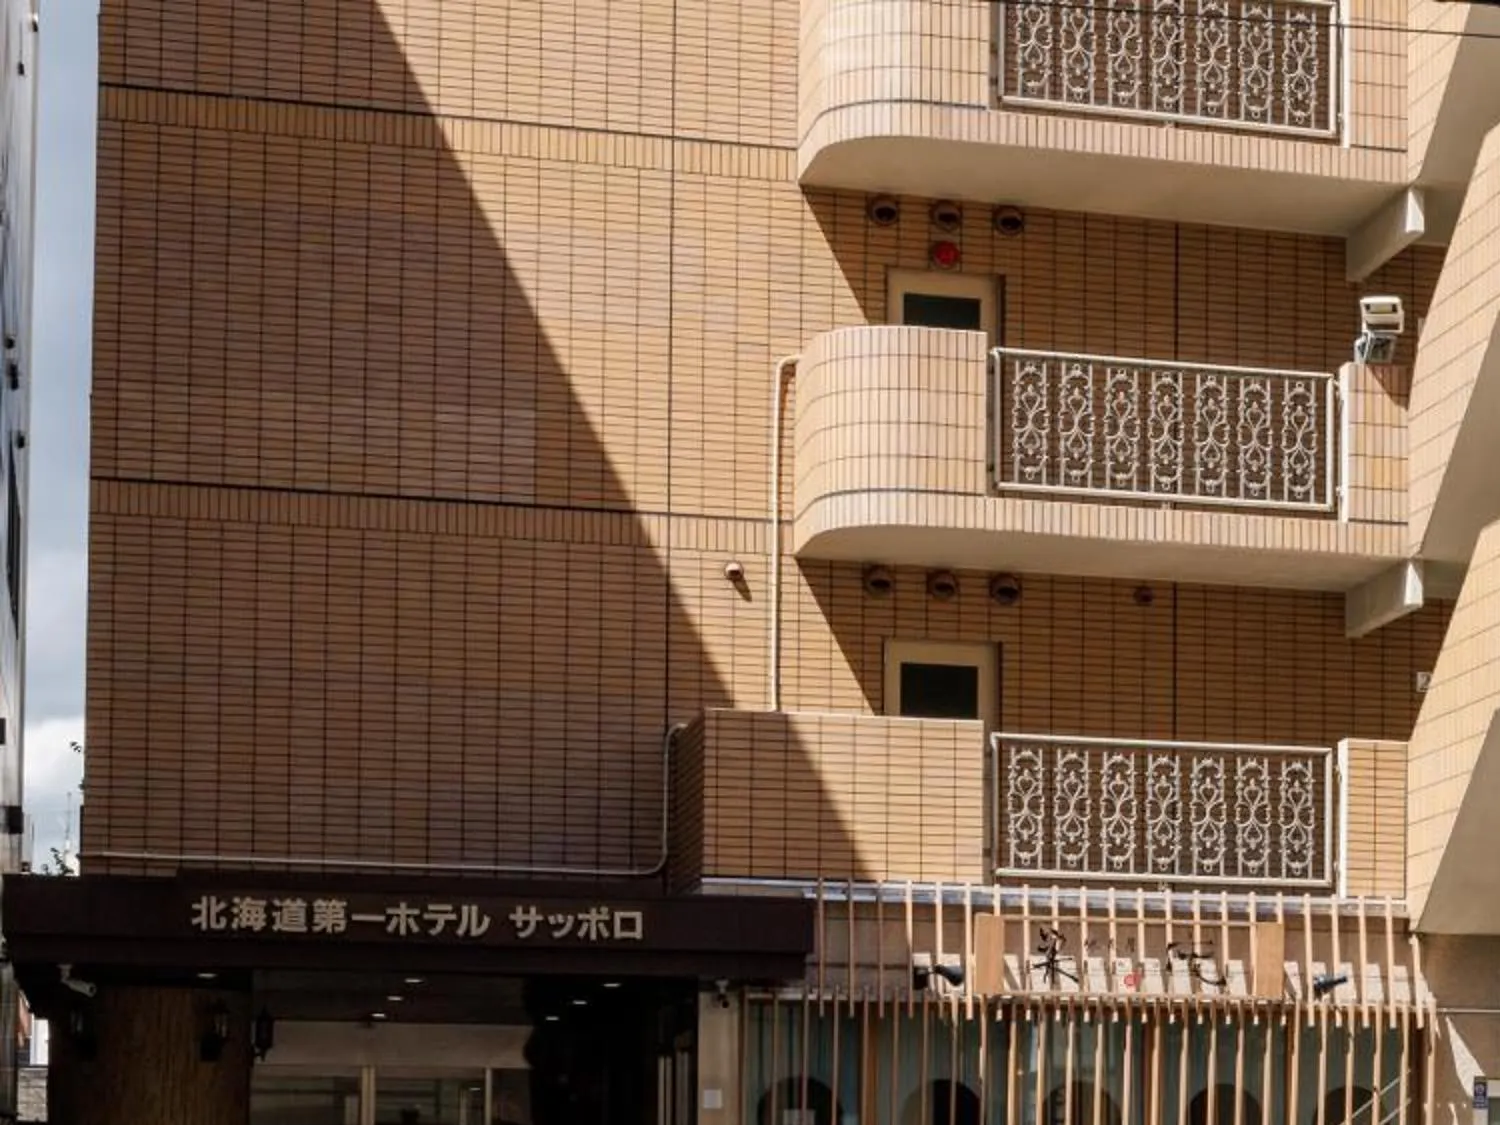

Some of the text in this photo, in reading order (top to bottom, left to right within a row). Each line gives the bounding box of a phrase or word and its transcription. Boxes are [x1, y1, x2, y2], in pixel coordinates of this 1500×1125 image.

[191, 895, 645, 941] 北海道第一ホテル サッポロ
